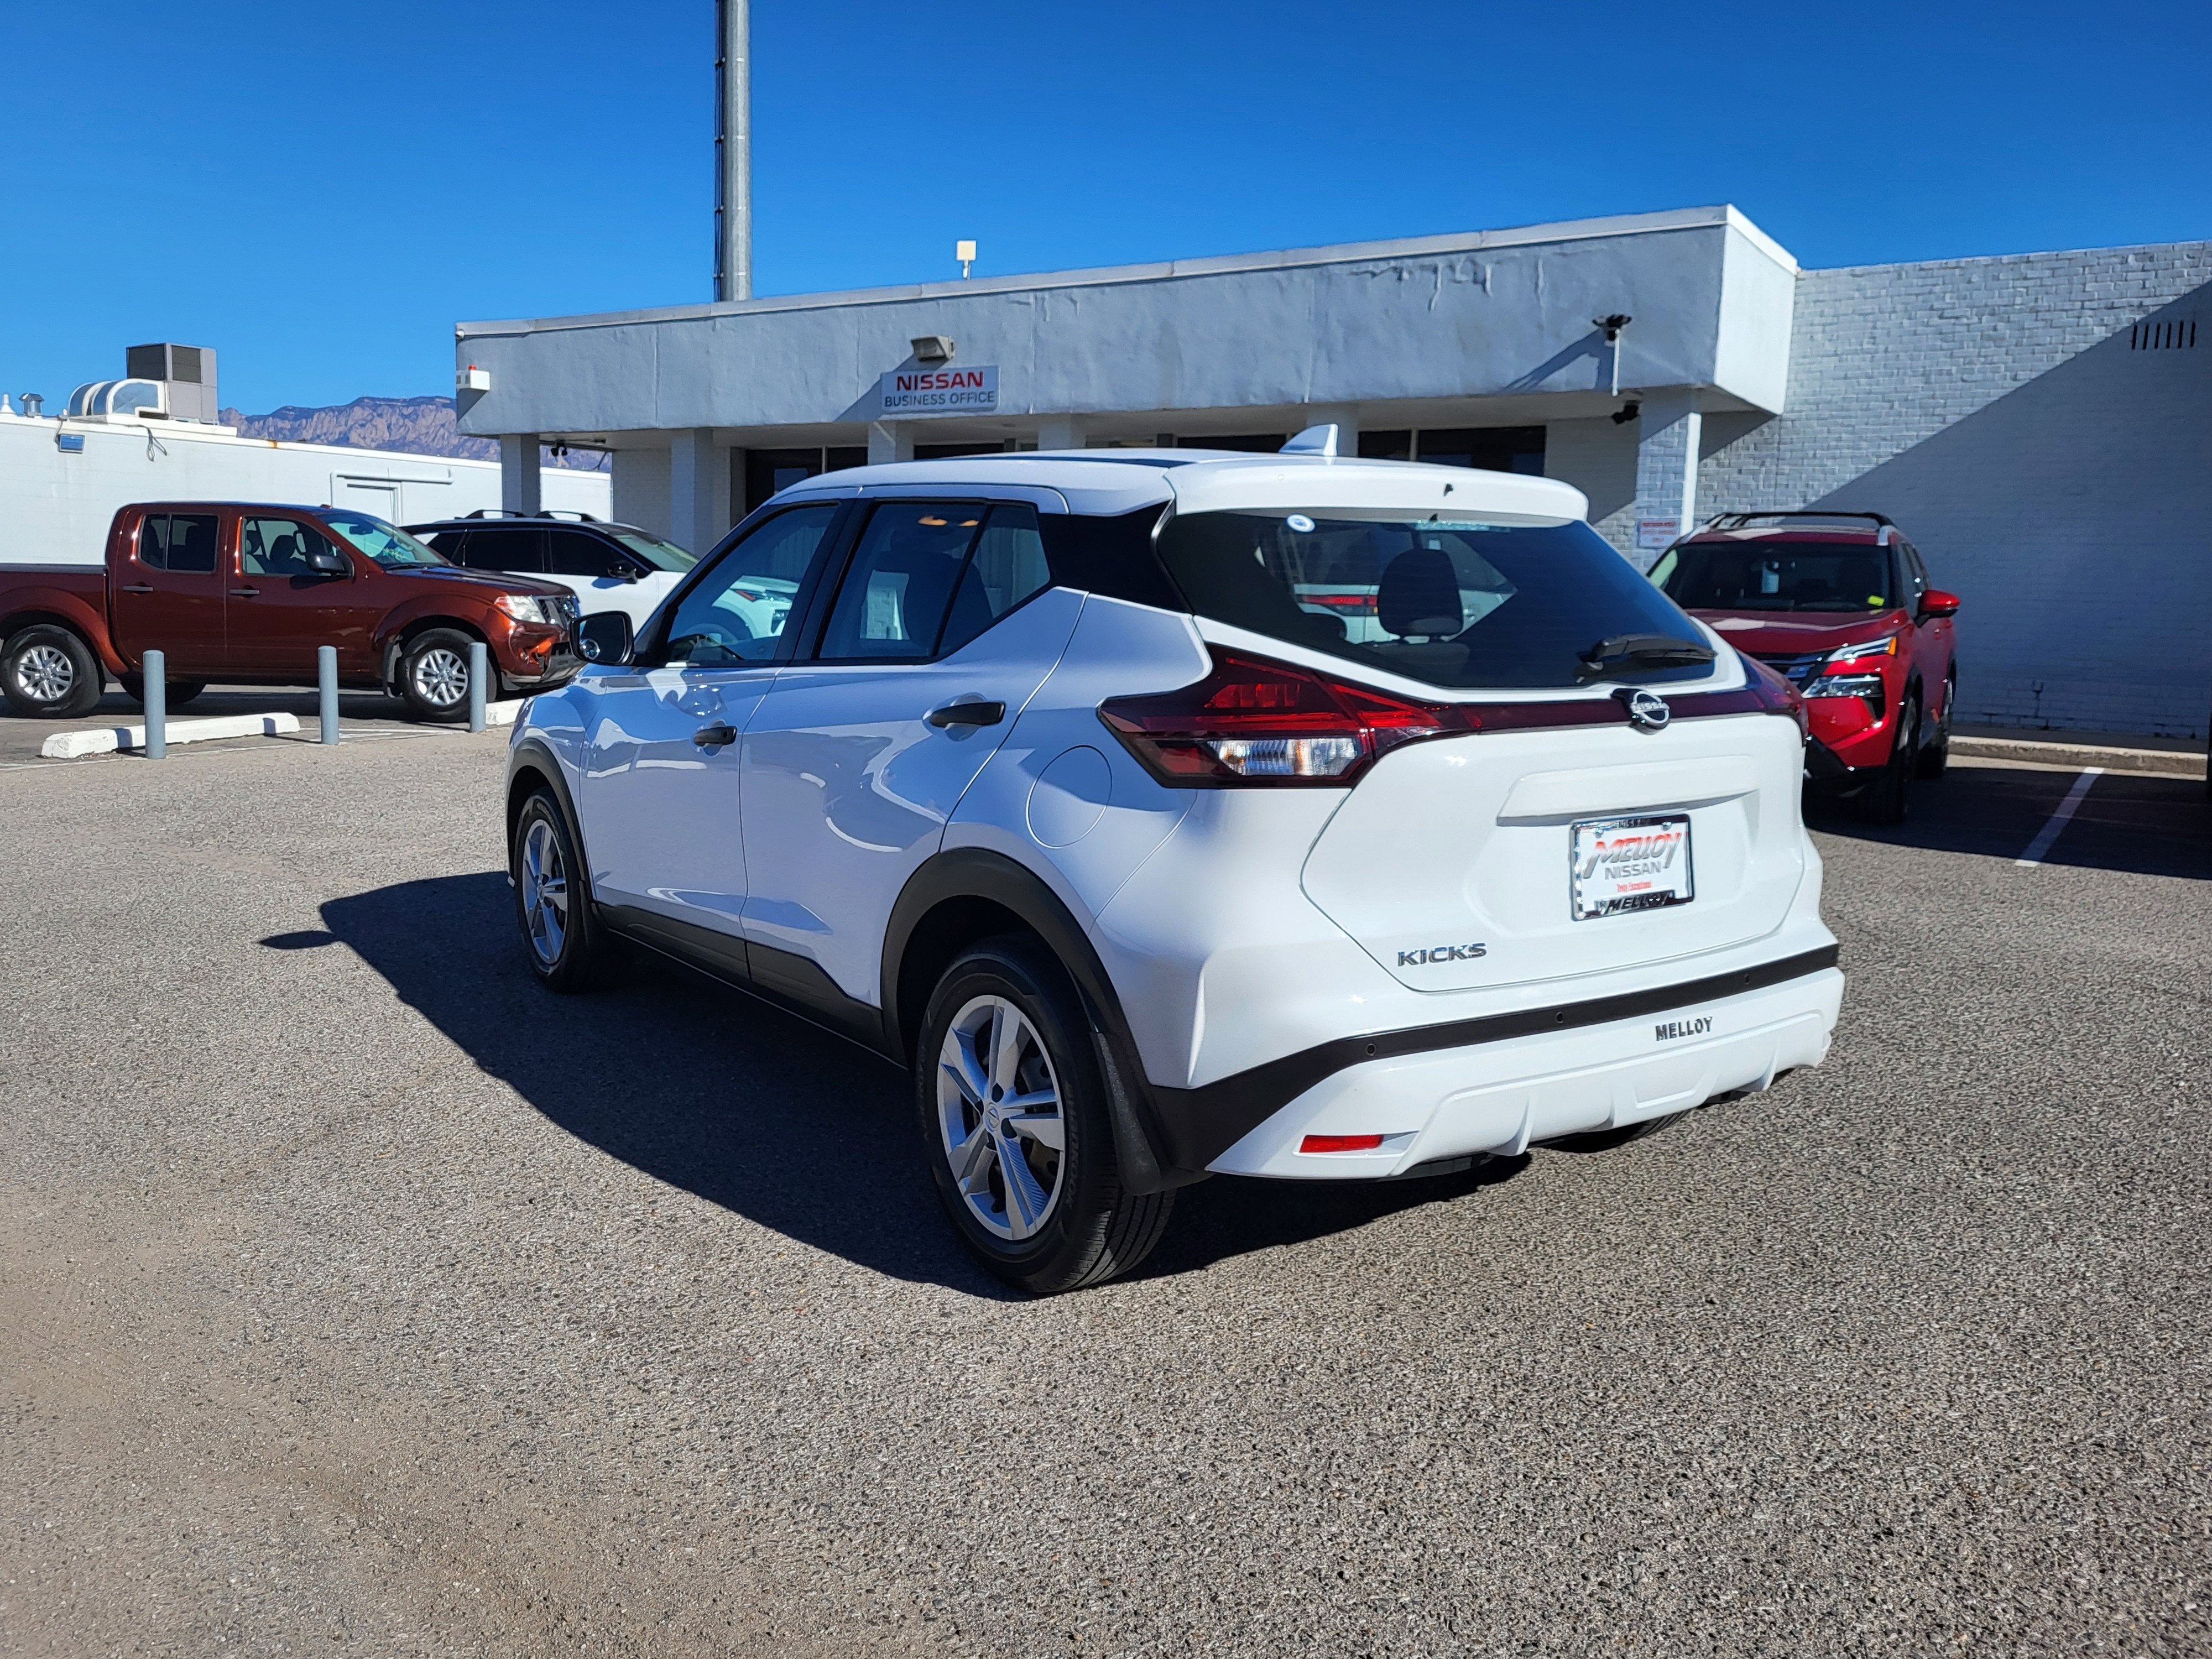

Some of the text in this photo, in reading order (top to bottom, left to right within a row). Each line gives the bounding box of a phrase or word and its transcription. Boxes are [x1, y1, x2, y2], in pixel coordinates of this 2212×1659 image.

[896, 371, 983, 391] NISSAN
[885, 390, 995, 407] BUSINESS OFFICE
[1583, 832, 1682, 879] MELLOY
[1605, 861, 1662, 880] NISSAN
[1398, 943, 1487, 967] KICKS
[1656, 1016, 1713, 1041] MELLOY
